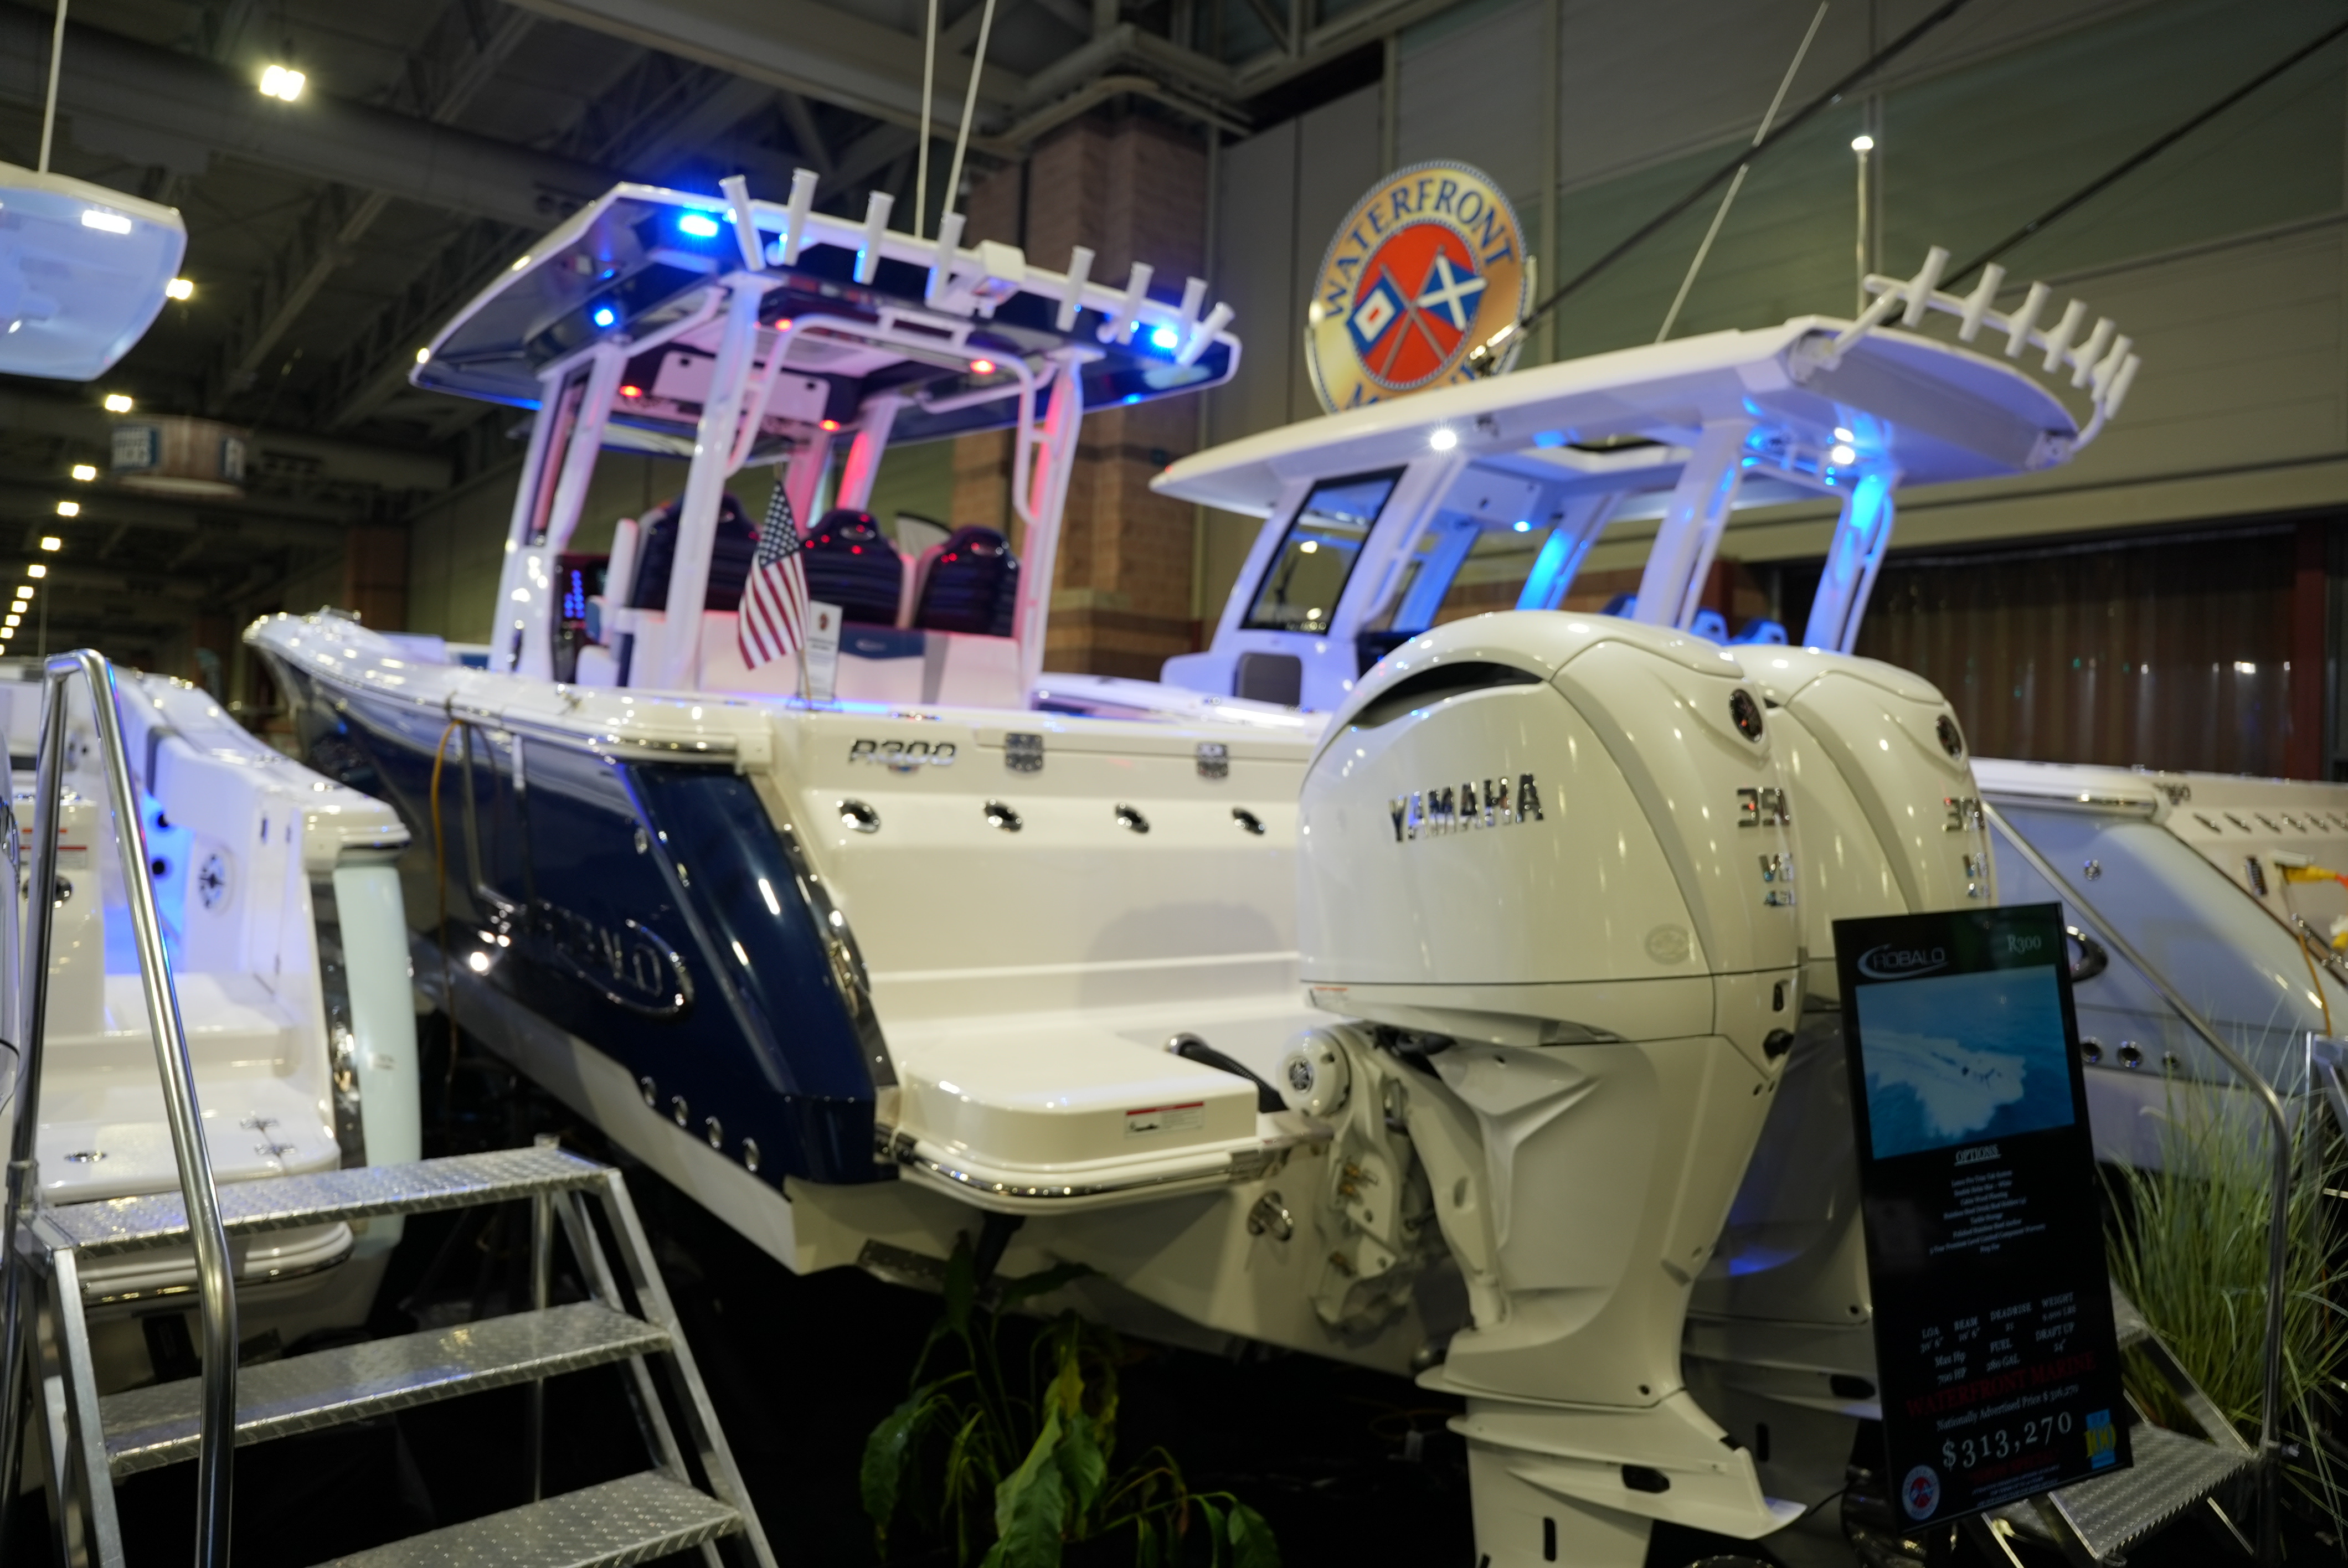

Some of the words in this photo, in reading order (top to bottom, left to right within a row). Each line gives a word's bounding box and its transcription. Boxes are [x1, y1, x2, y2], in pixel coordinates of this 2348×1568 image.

[1325, 178, 1515, 317] WATERFRONT
[1388, 772, 1544, 842] YAMAHA
[2006, 933, 2042, 954] R300
[1872, 947, 1945, 970] ROBALO
[1955, 1143, 2000, 1162] OPTIONS
[2041, 1291, 2074, 1308] WEIGHT
[1990, 1302, 2033, 1322] DEADRISE
[1921, 1326, 1941, 1340] LOA
[1953, 1316, 1979, 1332] BEAM
[2035, 1324, 2062, 1342] DRAFT
[1989, 1338, 2014, 1354] FUEL
[1906, 1368, 2028, 1418] WATERFRONT
[2030, 1350, 2097, 1386] MARINE
[1936, 1409, 1979, 1432] Nationally
[1979, 1397, 2021, 1421] Advertised
[2021, 1393, 2042, 1410] Price
[1942, 1411, 2073, 1472] $313,270
